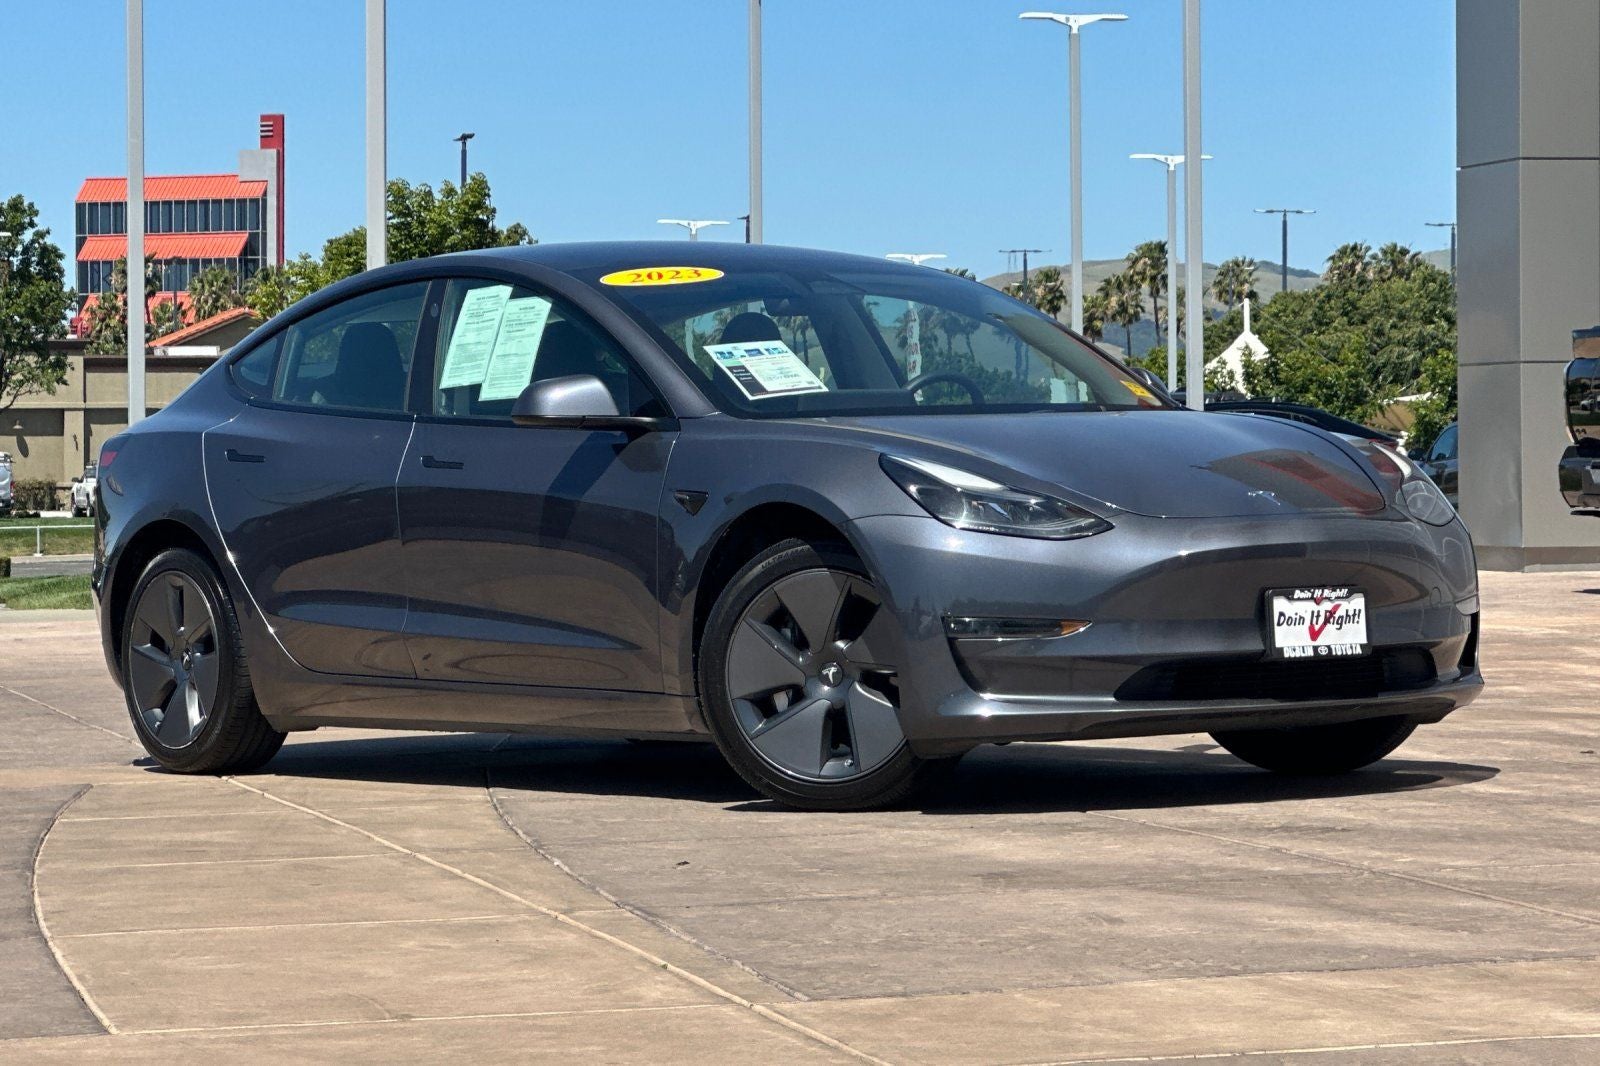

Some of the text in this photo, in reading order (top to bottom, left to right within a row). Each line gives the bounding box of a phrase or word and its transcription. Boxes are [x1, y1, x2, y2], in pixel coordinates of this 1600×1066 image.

[627, 269, 702, 283] 2023
[1314, 588, 1322, 598] It
[1323, 588, 1349, 600] Right!
[1310, 609, 1322, 626] It
[1323, 608, 1362, 631] Right!
[1283, 643, 1362, 658] DUBLIN TOYOTA
